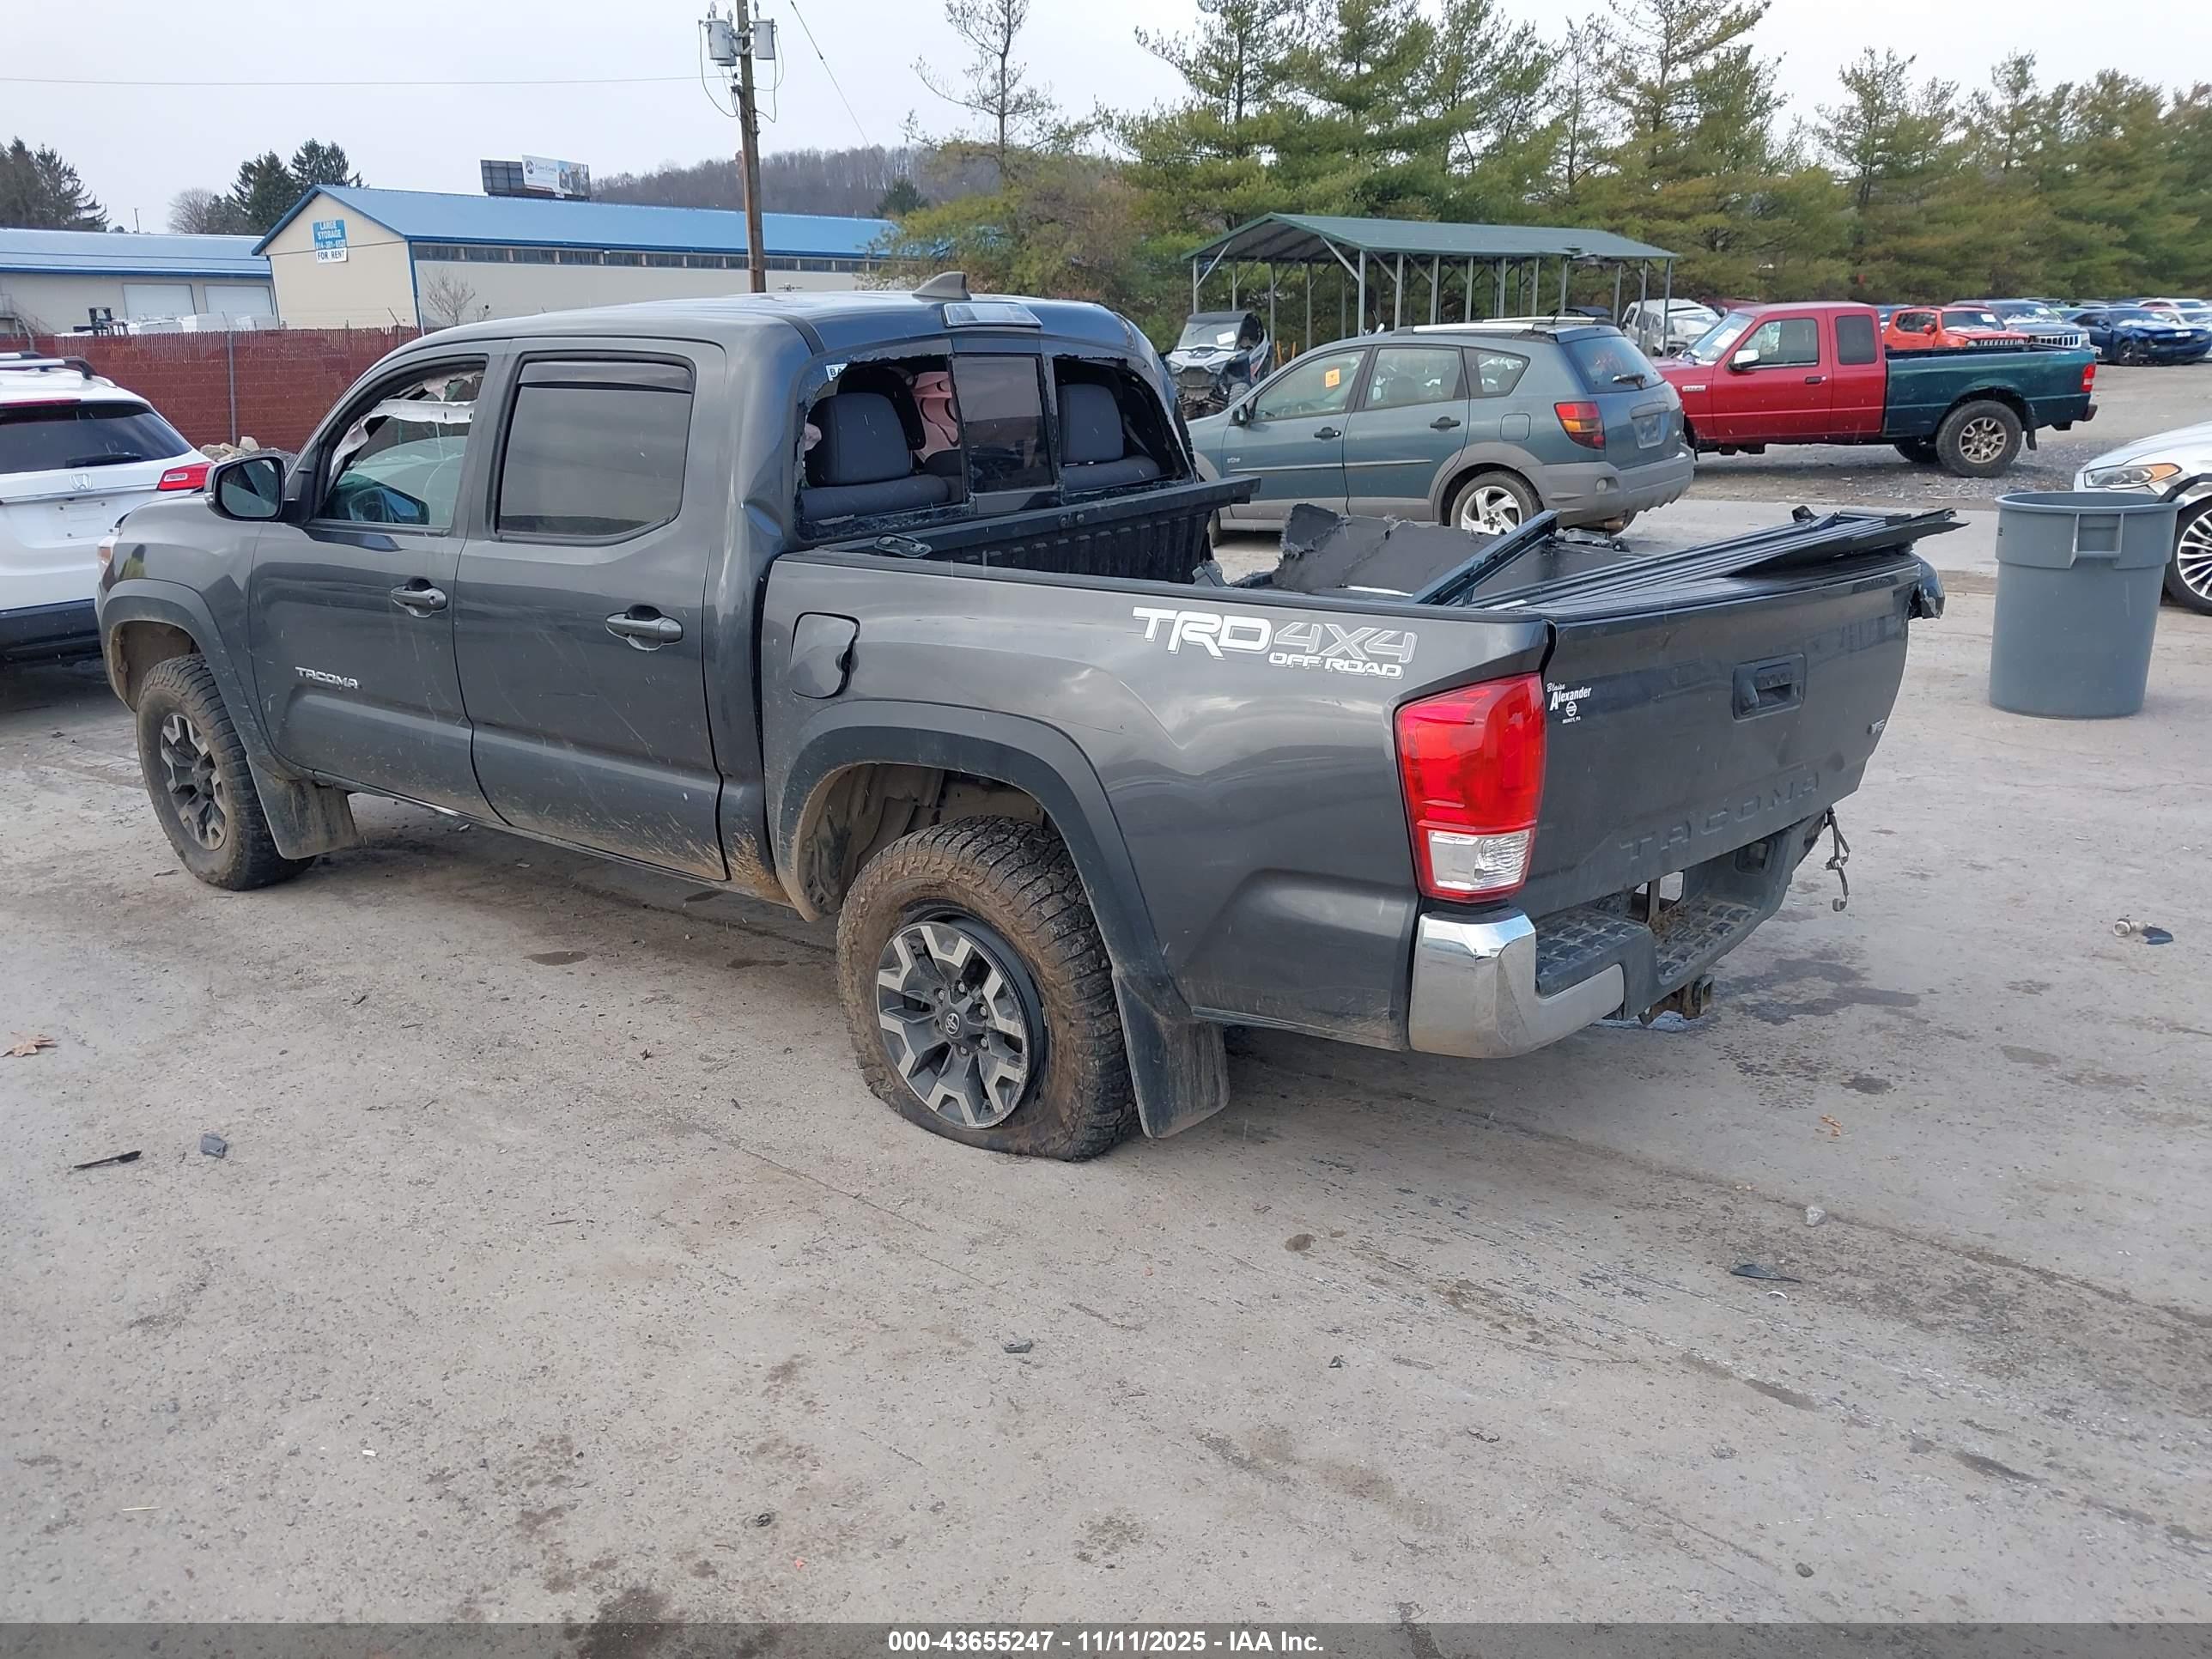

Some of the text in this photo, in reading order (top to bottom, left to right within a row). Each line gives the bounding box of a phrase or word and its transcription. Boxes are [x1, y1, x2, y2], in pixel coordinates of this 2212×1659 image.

[317, 229, 342, 240] STORAGE
[319, 220, 337, 230] LARGE
[317, 249, 345, 260] FOR RENT
[1132, 605, 1272, 661] TRD
[295, 666, 359, 690] TACOMA
[1268, 651, 1405, 680] OFF ROAD
[1549, 686, 1592, 712] Alexander
[1619, 770, 1819, 862] TACOMA
